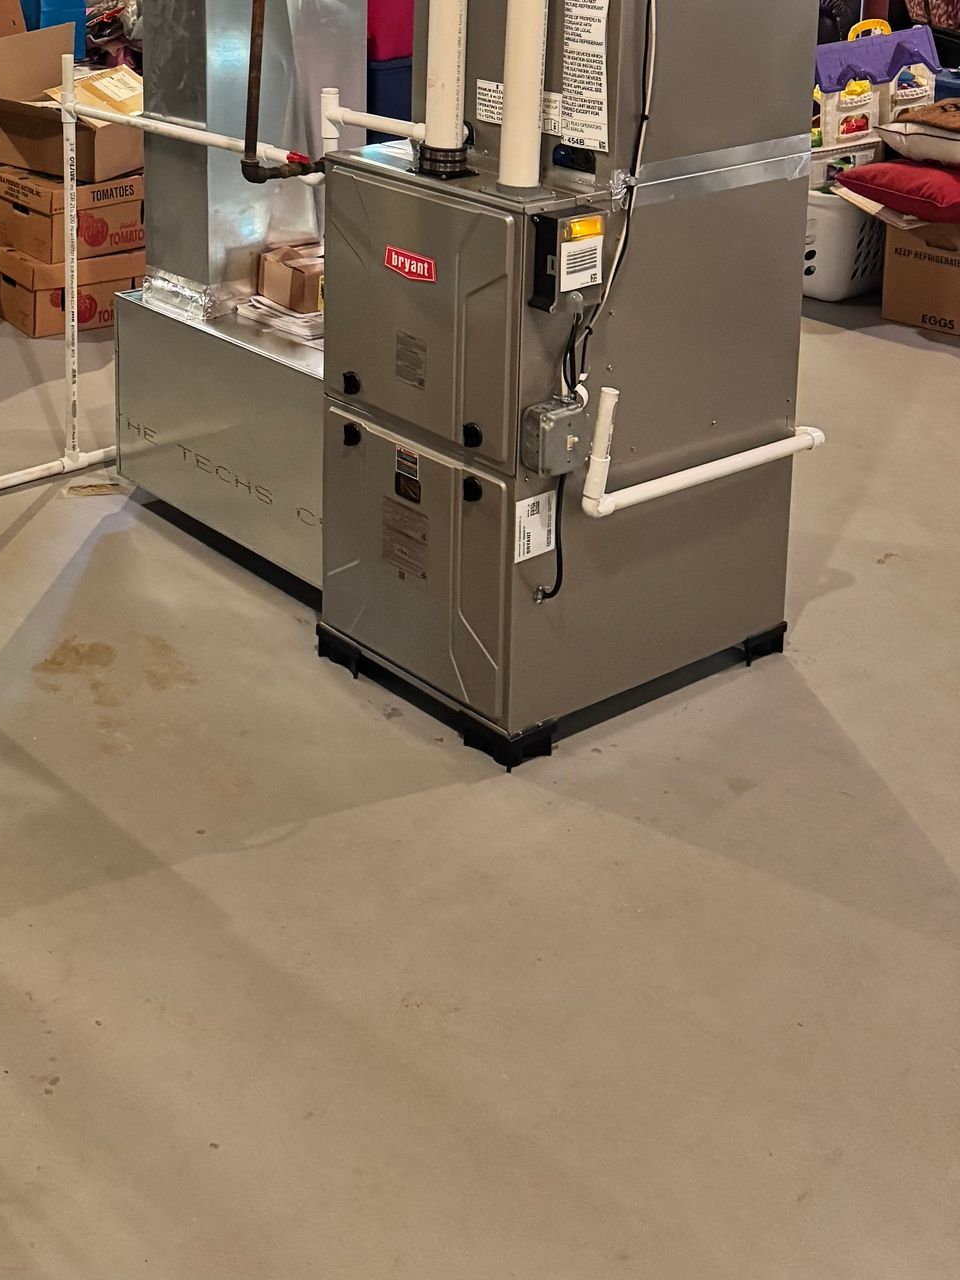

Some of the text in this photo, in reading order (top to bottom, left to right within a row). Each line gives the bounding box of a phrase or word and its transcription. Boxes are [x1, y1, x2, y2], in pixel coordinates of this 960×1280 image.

[567, 137, 585, 146] 454B
[91, 184, 135, 202] TOMATOES
[894, 247, 913, 257] KEEP
[391, 251, 429, 277] bryant
[921, 314, 955, 330] EGGS
[177, 443, 273, 505] TECHS
